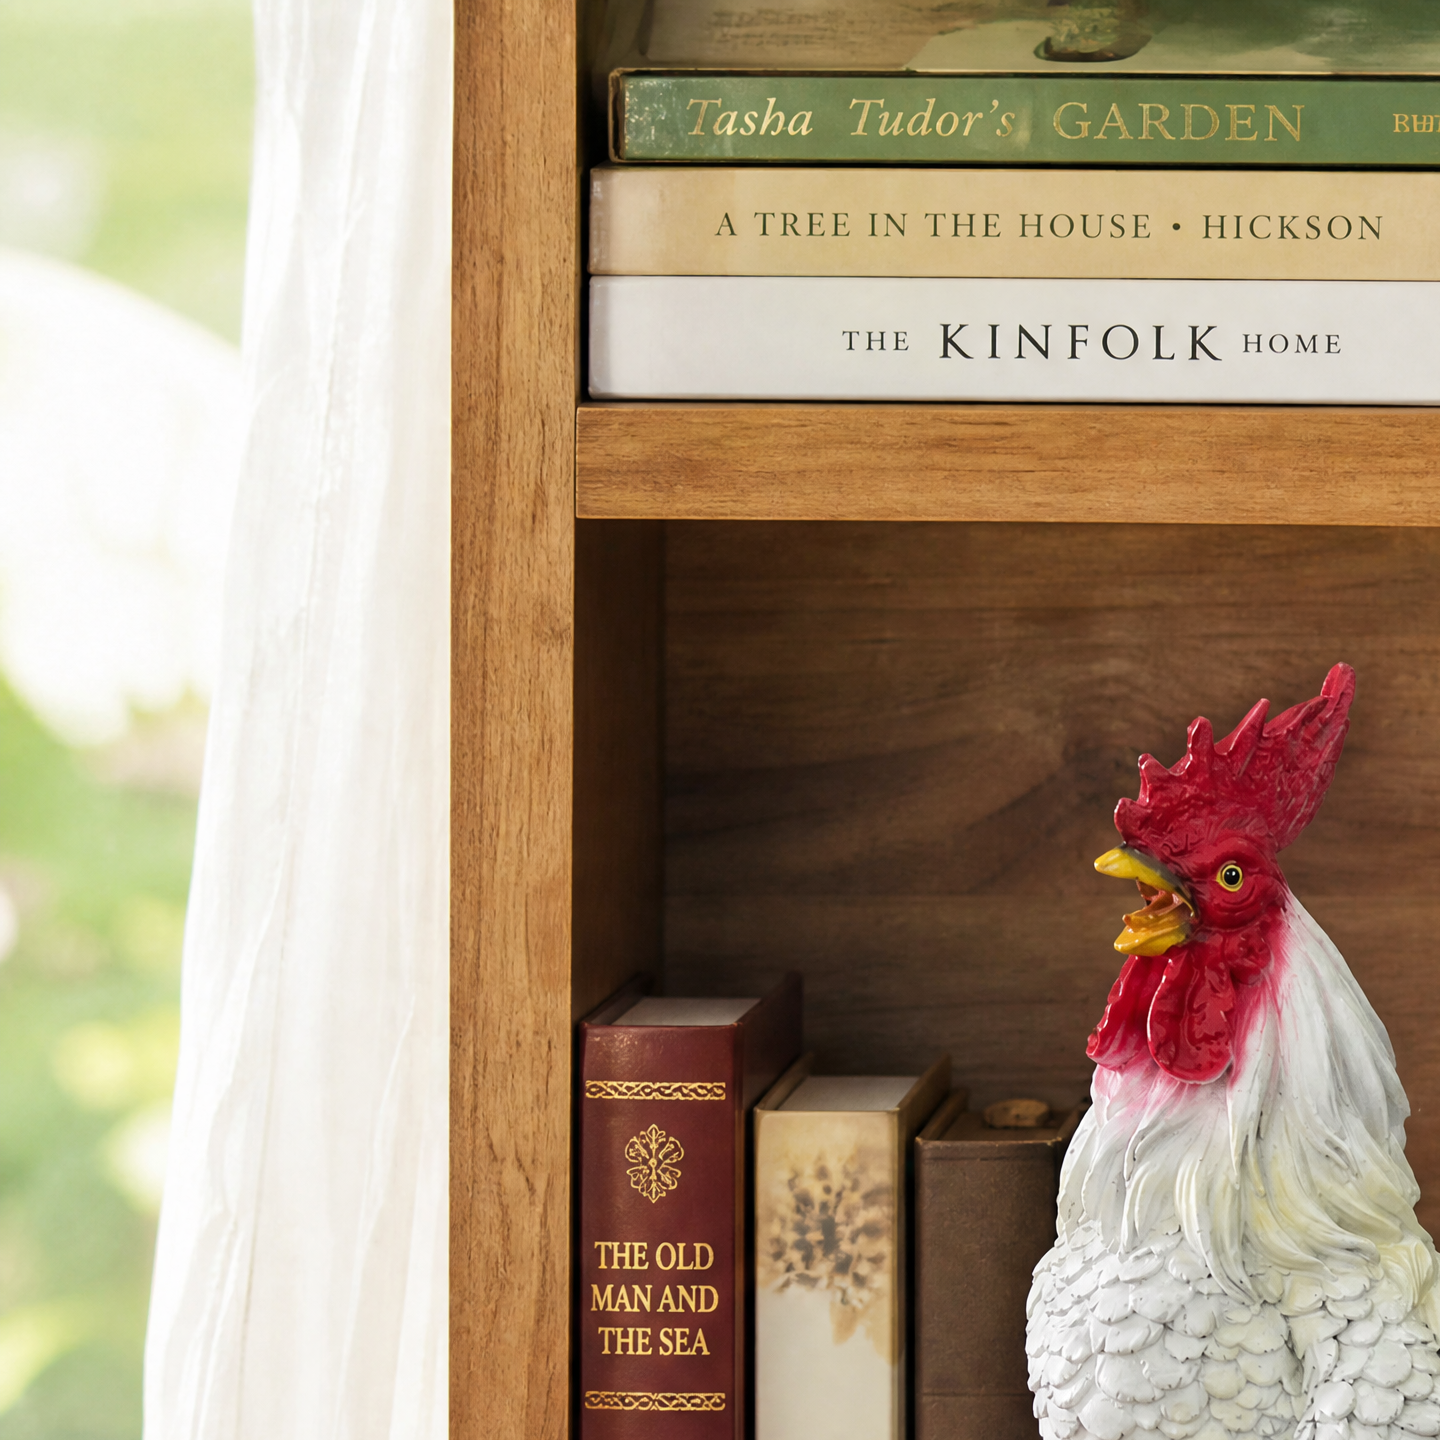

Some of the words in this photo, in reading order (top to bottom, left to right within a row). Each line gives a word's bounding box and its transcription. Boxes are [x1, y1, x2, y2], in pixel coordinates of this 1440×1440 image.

[687, 98, 812, 135] Tasha
[850, 98, 1016, 137] Tudor's
[1053, 102, 1304, 141] GARDEN
[716, 213, 736, 235] A
[754, 213, 849, 236] TREE
[870, 214, 906, 236] IN
[925, 214, 1000, 237] THE
[1020, 214, 1150, 238] HOUSE
[1204, 216, 1380, 239] HICKSON
[843, 331, 908, 350] THE
[940, 324, 1221, 360] KINFOLK
[1244, 334, 1340, 353] HOME
[595, 1242, 649, 1269] THE
[656, 1242, 713, 1270] OLD
[591, 1284, 652, 1312] MAN
[657, 1285, 718, 1312] AND
[599, 1328, 652, 1355] THE
[659, 1328, 710, 1355] SEA
